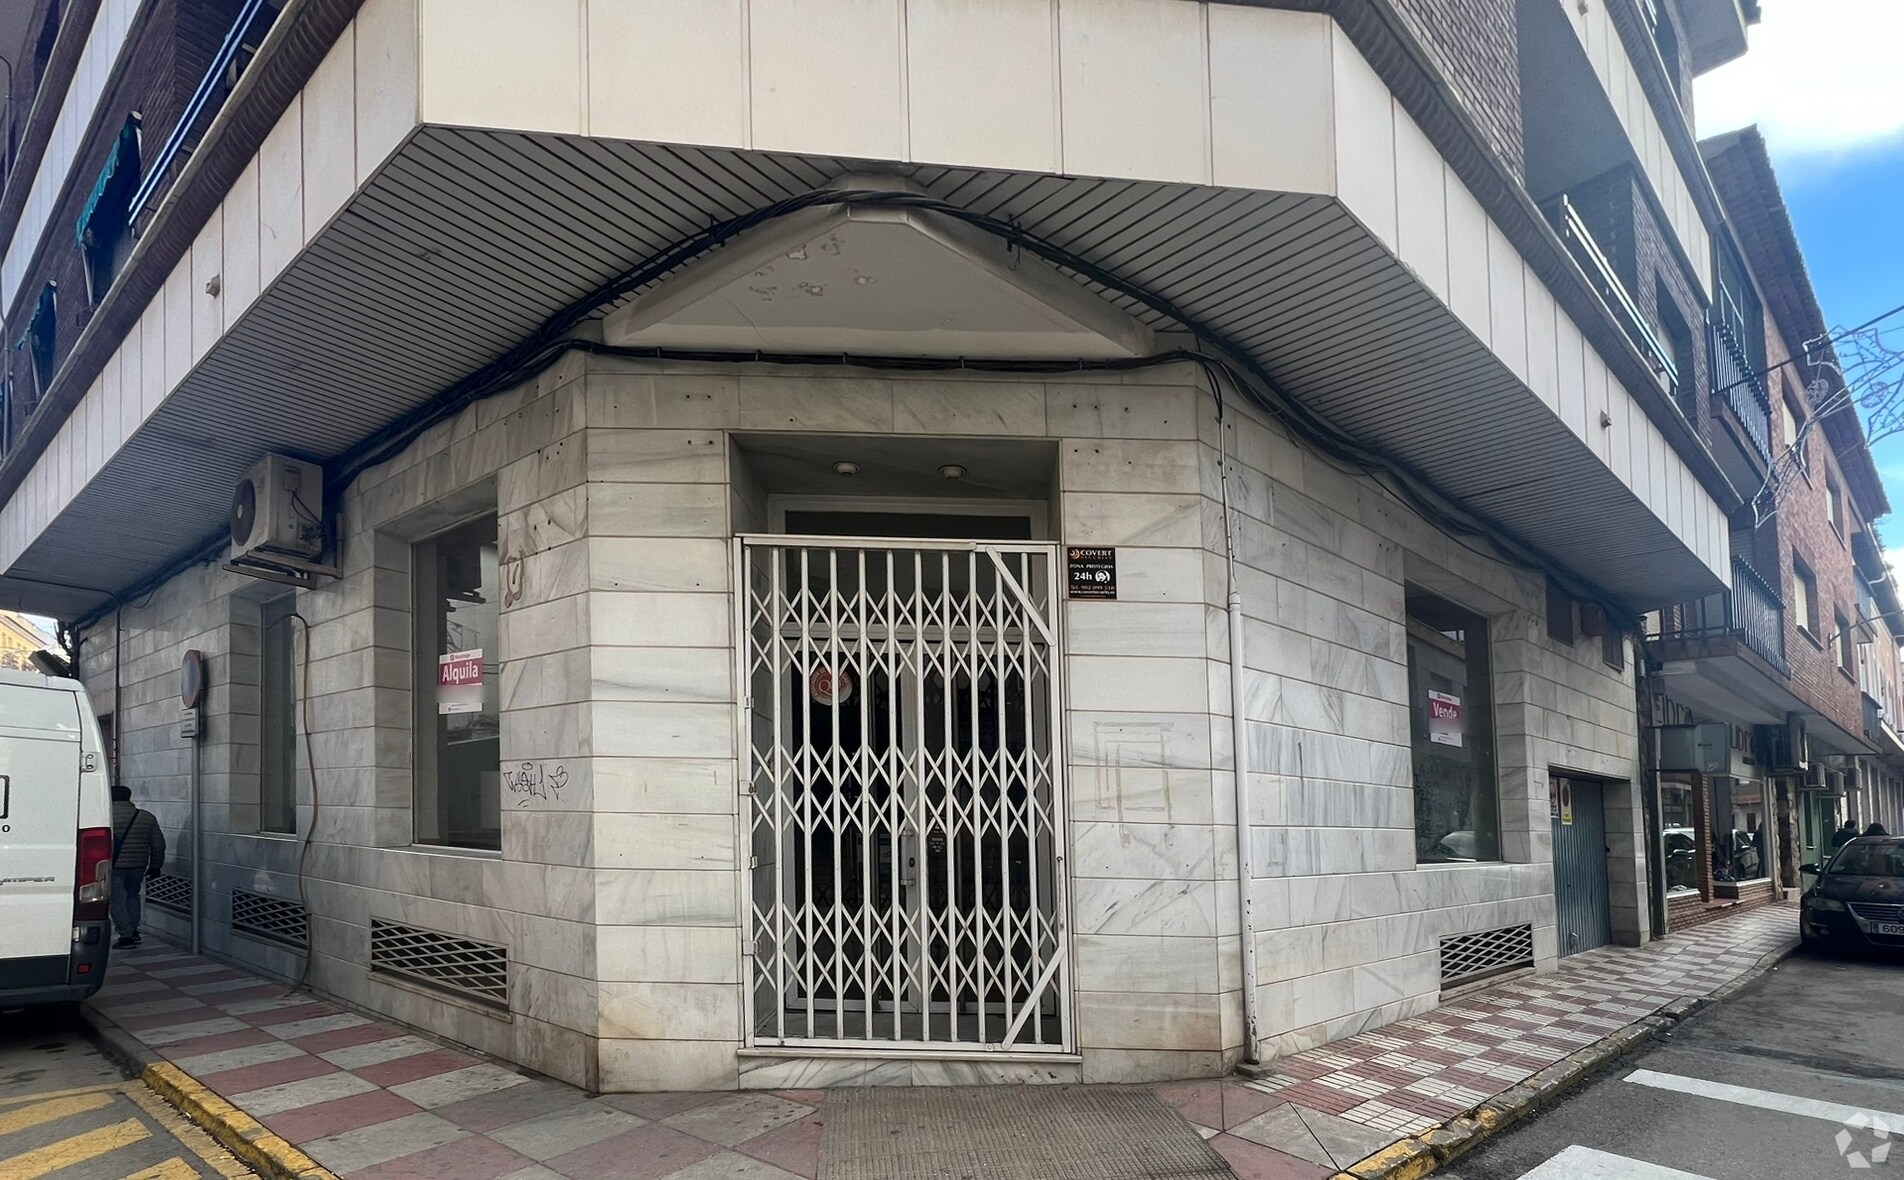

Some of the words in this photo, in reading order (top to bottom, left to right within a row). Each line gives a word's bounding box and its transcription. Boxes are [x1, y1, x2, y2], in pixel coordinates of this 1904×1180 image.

[1073, 571, 1093, 580] 24h
[442, 660, 479, 685] Alquila
[1432, 701, 1458, 719] Vende
[1882, 924, 1904, 934] 609
